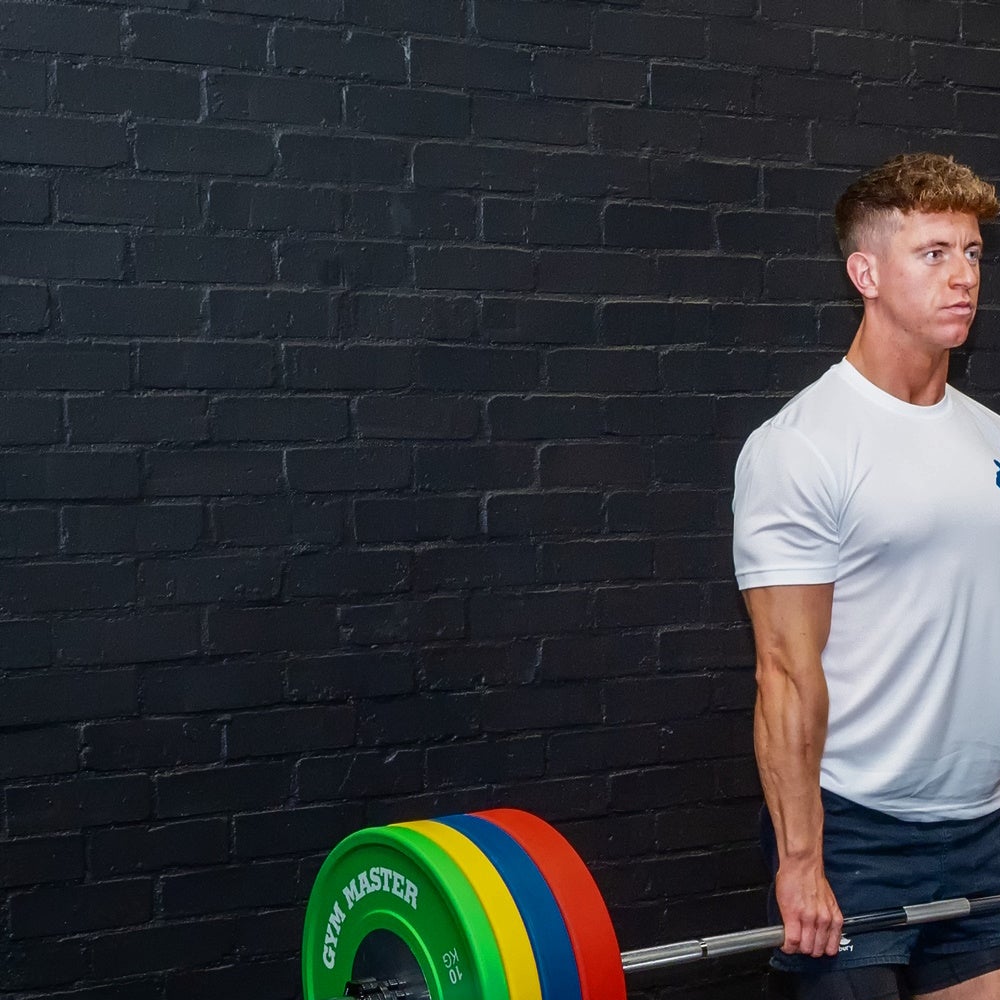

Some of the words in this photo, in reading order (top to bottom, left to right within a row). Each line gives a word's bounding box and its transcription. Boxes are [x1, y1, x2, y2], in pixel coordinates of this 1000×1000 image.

[323, 901, 346, 969] GYM
[342, 867, 418, 910] MASTER
[442, 947, 459, 968] KG
[449, 965, 463, 984] 10
